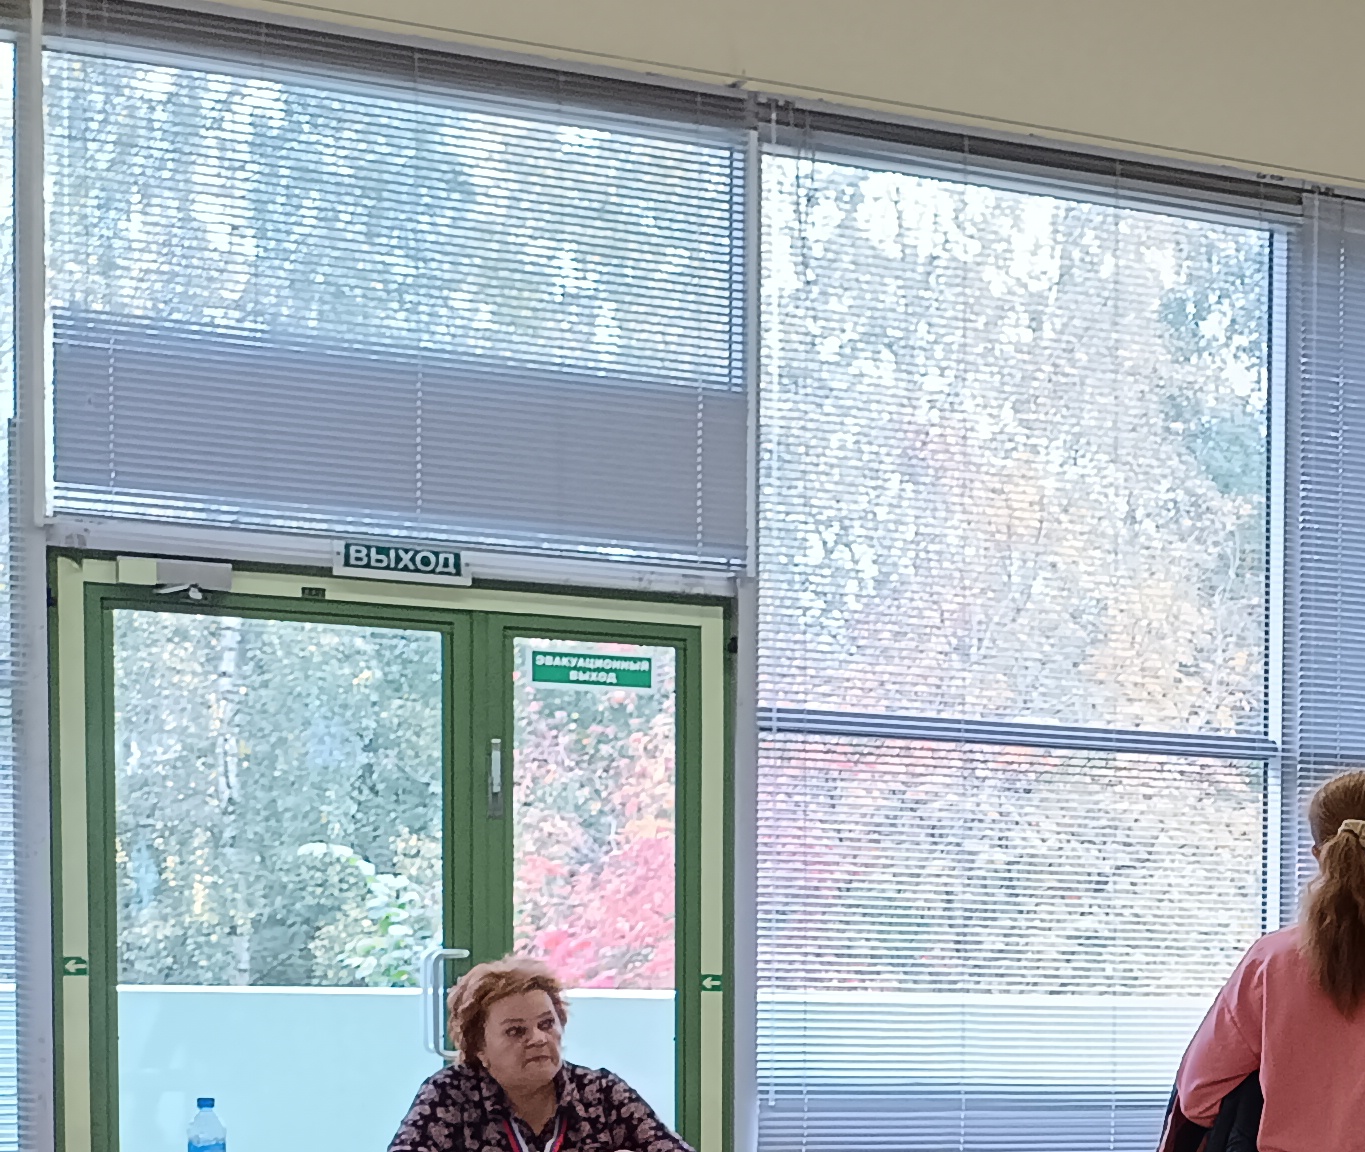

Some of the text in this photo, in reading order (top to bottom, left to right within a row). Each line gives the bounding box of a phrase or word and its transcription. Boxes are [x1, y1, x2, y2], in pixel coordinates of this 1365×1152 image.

[349, 545, 457, 574] ВЫХОД
[535, 654, 650, 671] ЭВАКУАЦИОННЫЙ
[569, 670, 618, 684] ВЫХОД
